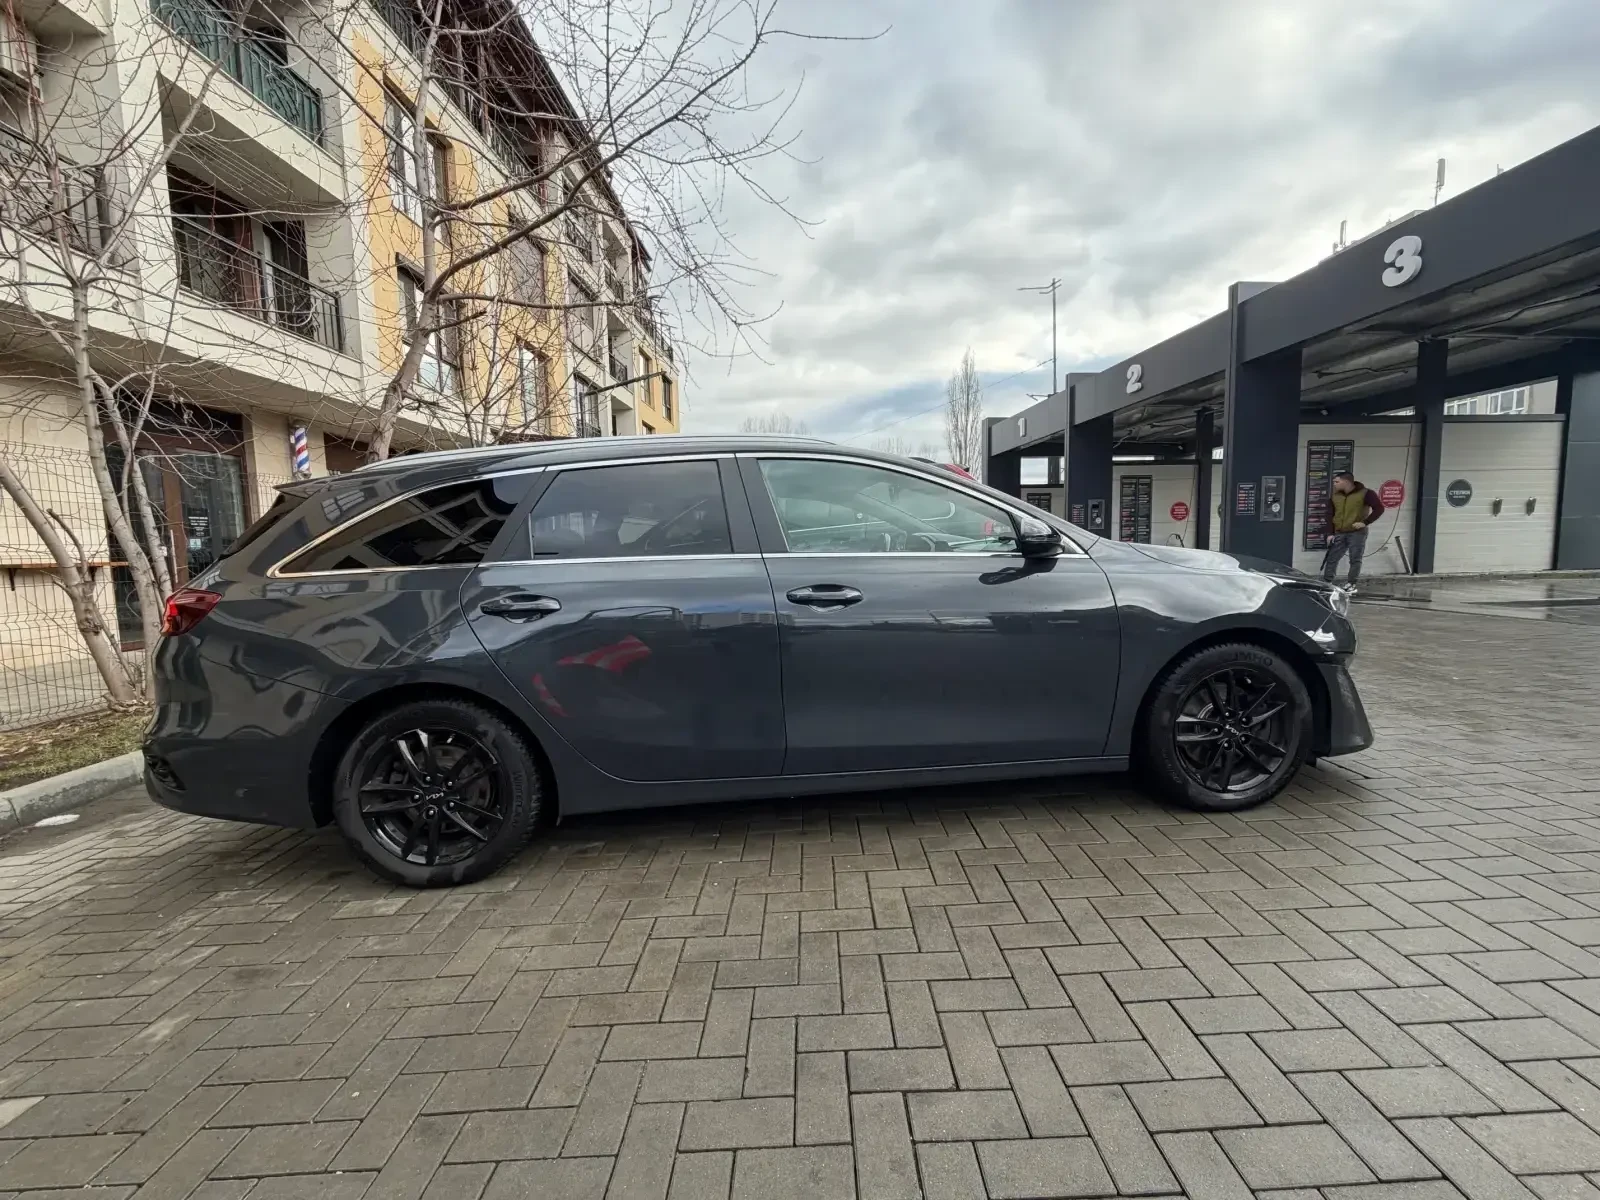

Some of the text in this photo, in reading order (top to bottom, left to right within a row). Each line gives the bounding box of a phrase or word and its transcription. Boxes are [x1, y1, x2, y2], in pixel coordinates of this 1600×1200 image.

[1382, 235, 1422, 287] 3
[1126, 364, 1143, 394] 2
[1017, 417, 1027, 438] 1
